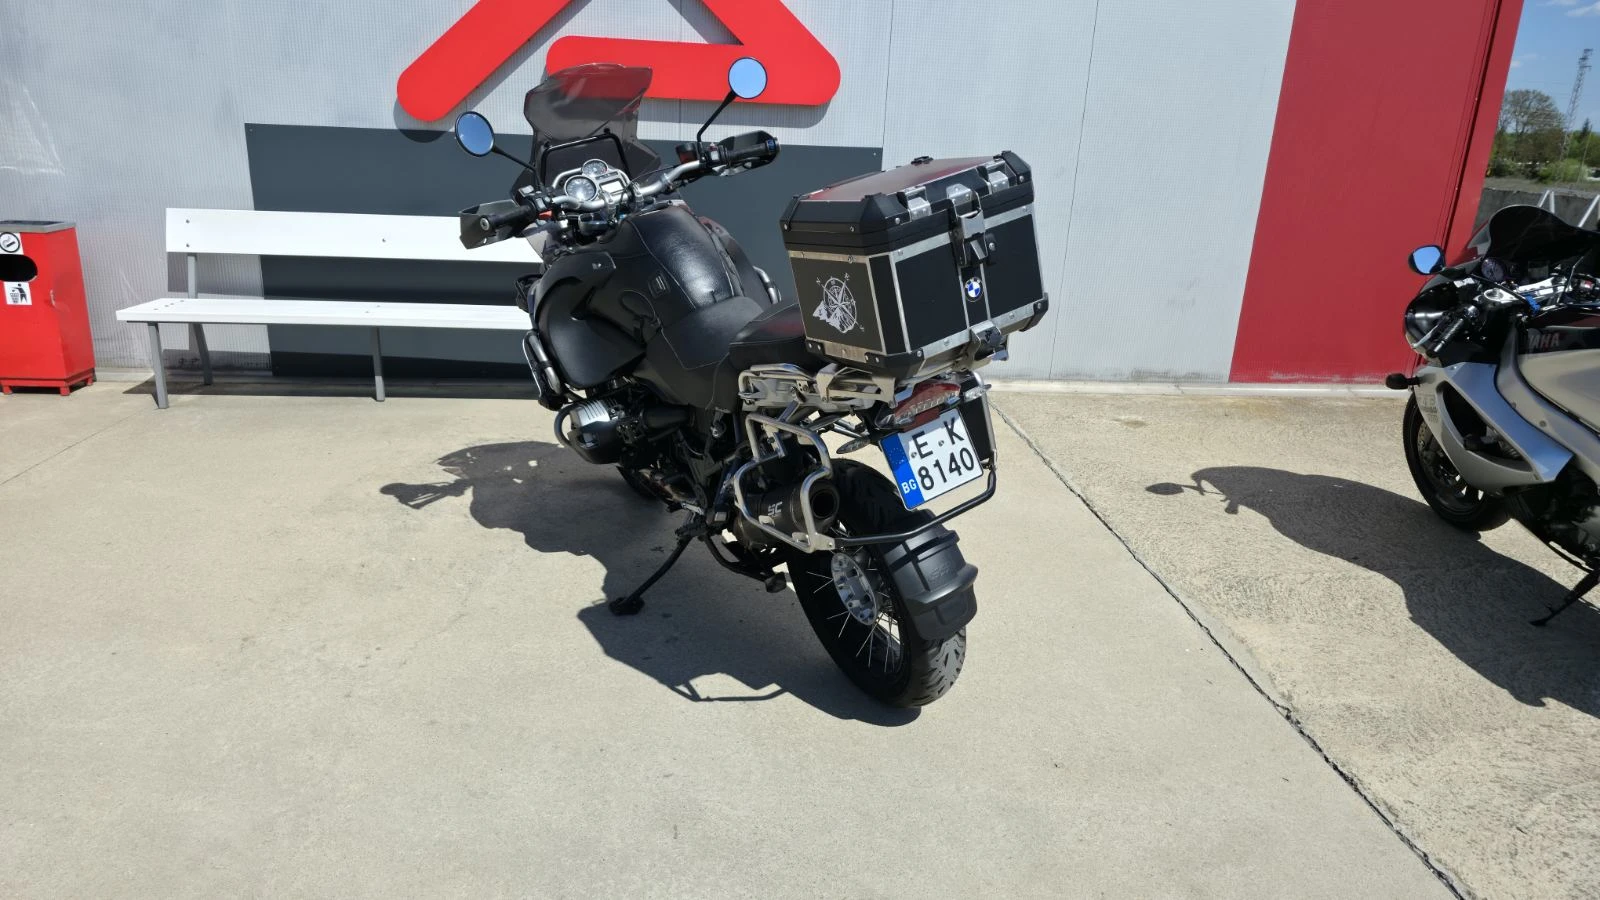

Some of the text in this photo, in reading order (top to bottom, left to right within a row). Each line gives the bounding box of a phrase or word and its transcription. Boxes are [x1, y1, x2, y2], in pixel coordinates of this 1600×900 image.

[912, 417, 965, 460] E K
[901, 478, 917, 494] BG
[918, 447, 975, 491] 8140
